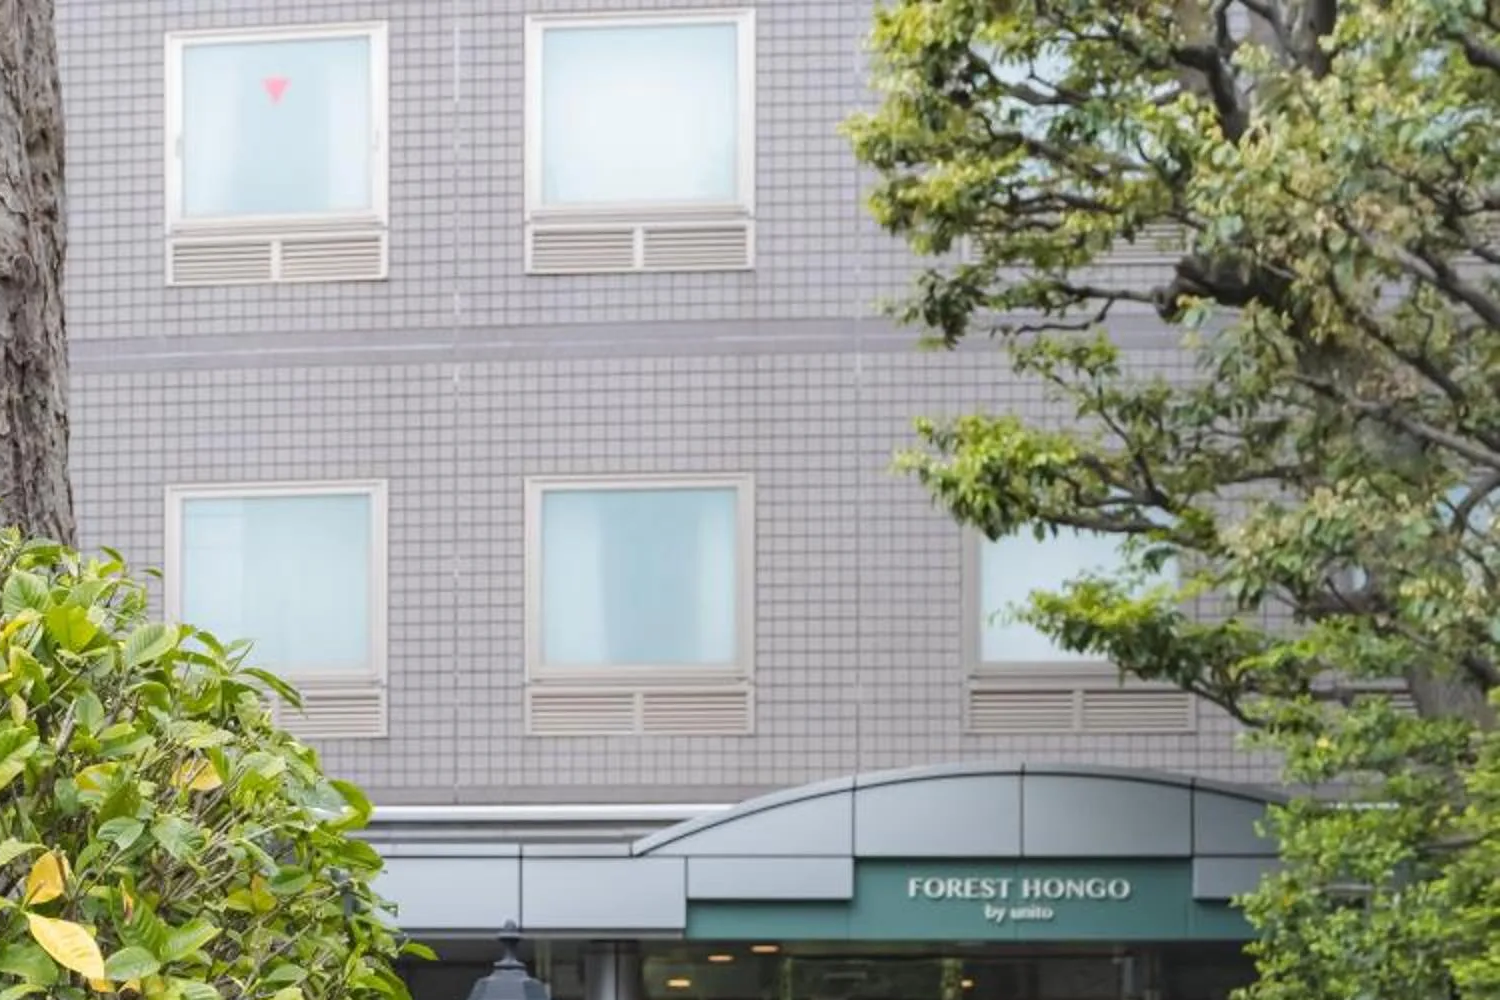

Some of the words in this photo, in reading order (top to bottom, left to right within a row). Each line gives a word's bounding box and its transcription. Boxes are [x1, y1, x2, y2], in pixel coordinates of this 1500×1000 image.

[907, 877, 1012, 898] FOREST
[1022, 877, 1131, 899] HONGO
[984, 903, 1006, 923] by
[1010, 903, 1054, 919] unito
